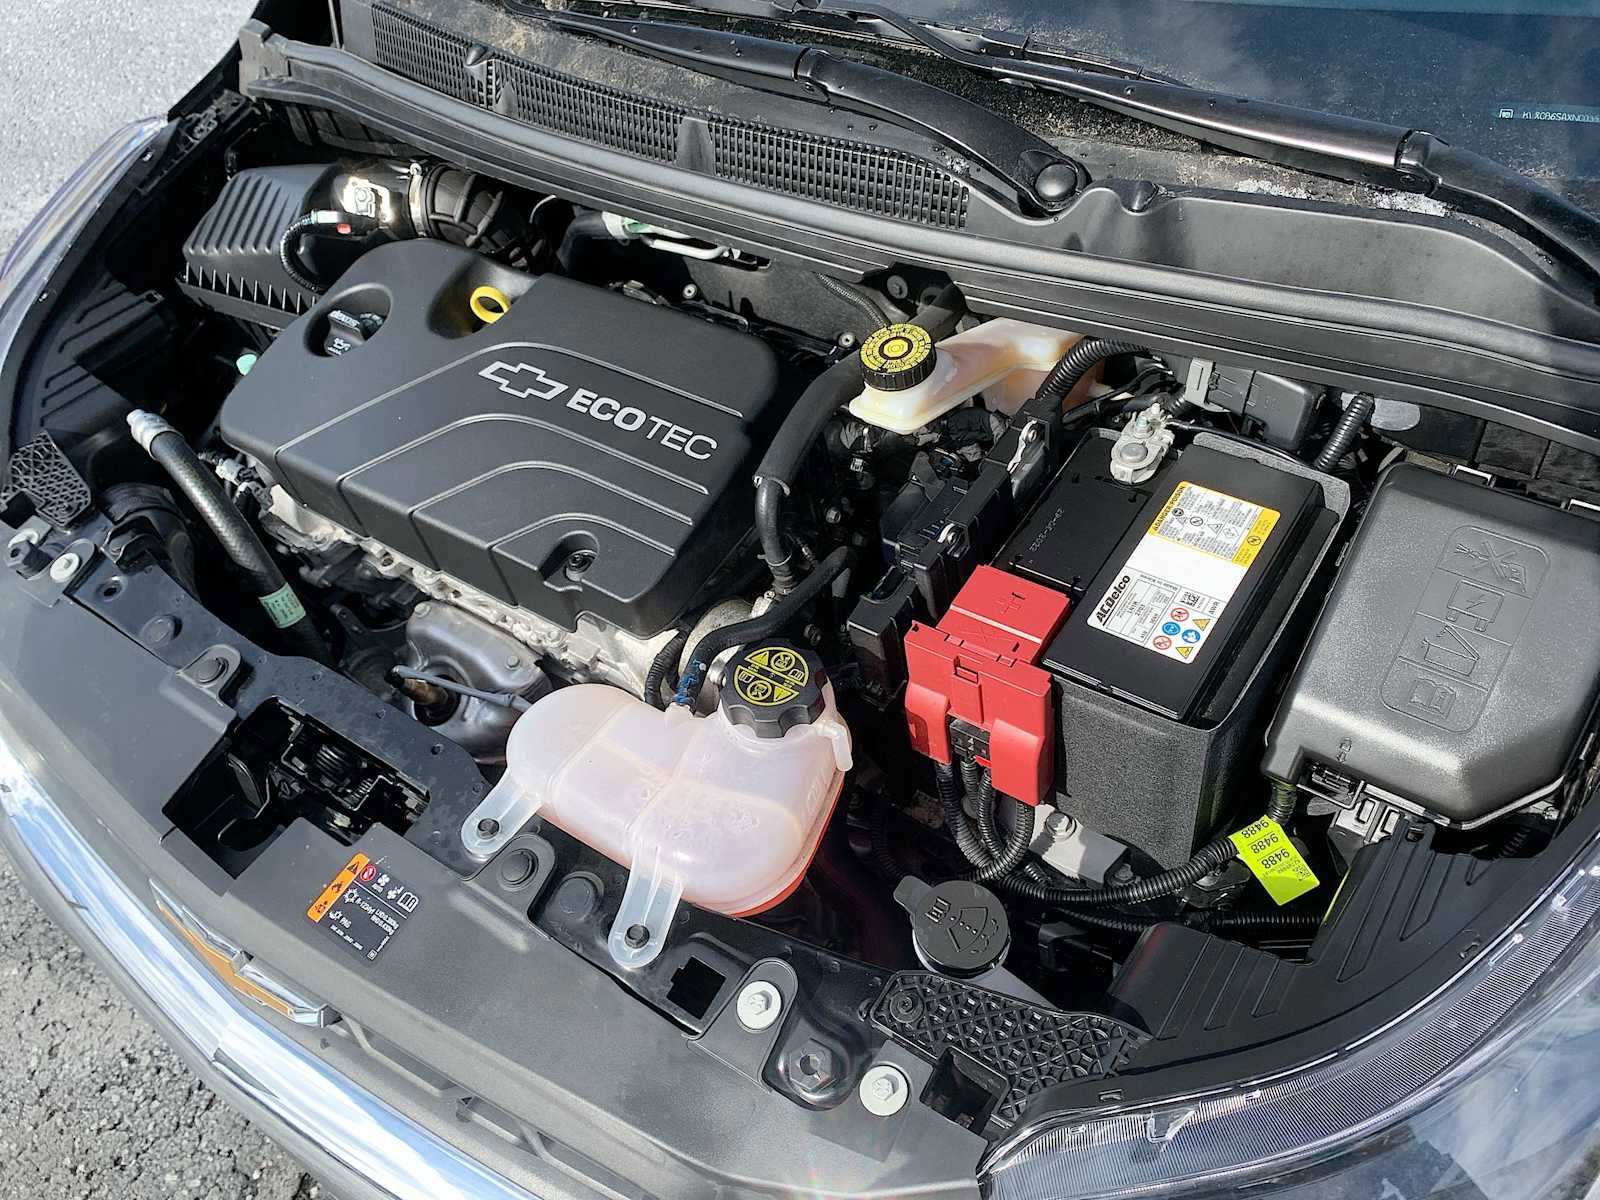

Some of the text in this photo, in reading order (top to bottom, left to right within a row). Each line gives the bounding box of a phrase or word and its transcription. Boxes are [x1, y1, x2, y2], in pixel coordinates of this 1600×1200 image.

[566, 388, 718, 460] ECOTEC
[1096, 575, 1130, 623] ACDelco
[1241, 819, 1270, 839] 9488
[1250, 833, 1279, 854] 9488
[1261, 848, 1290, 869] 9488
